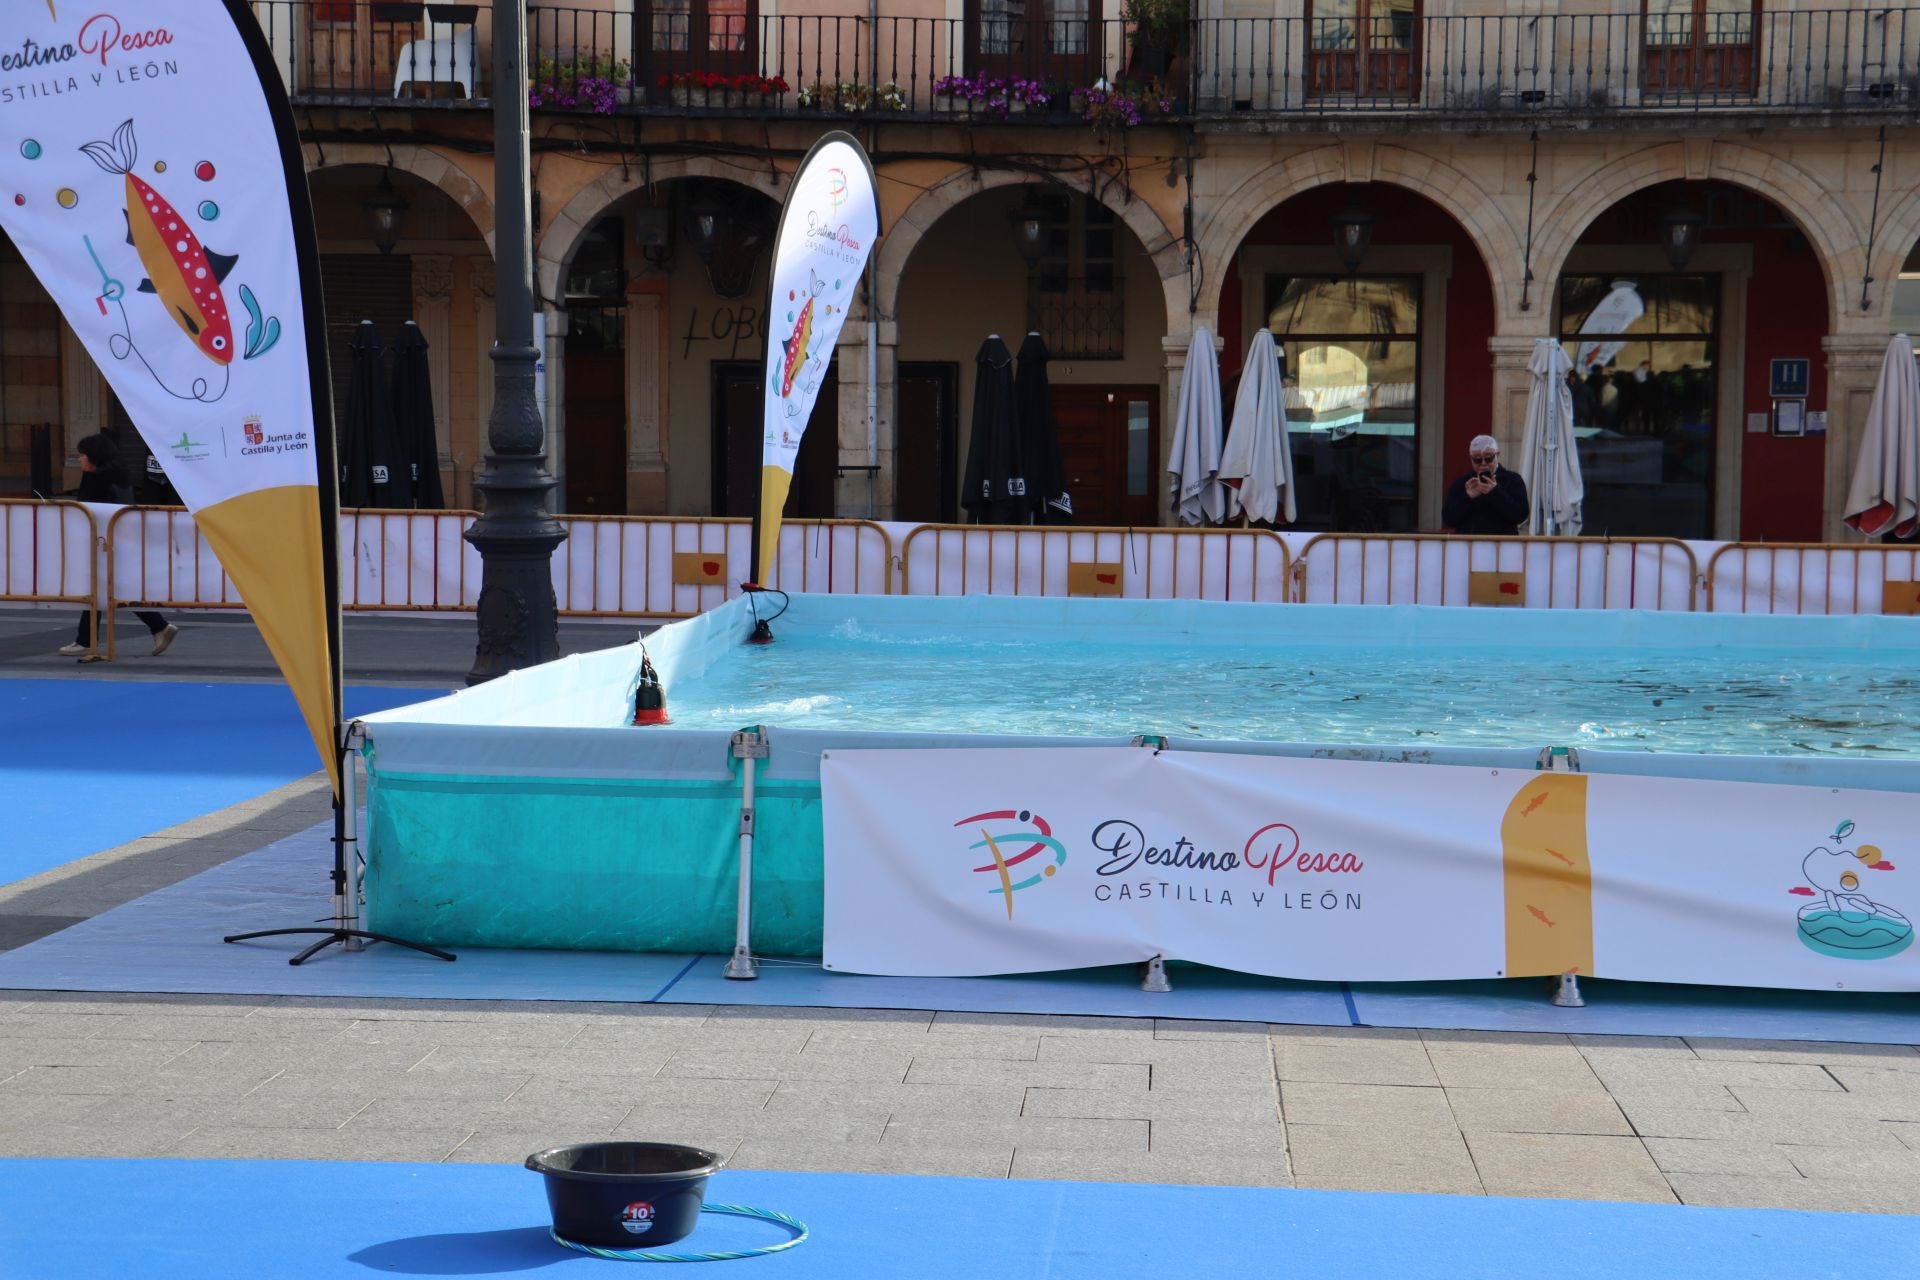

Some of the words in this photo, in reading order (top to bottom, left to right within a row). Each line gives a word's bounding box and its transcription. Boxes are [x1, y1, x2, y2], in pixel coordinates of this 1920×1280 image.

[1, 38, 77, 72] estino
[78, 13, 173, 66] Pesca
[1, 75, 78, 103] STILLA
[91, 73, 102, 87] Y
[117, 60, 178, 83] LEÓN
[837, 223, 860, 251] Pesca
[240, 445, 275, 456] Castilla
[276, 445, 282, 454] y
[284, 441, 308, 451] León
[266, 434, 293, 443] Junta
[295, 432, 307, 440] de
[1091, 819, 1241, 877] Destino
[1244, 823, 1364, 887] Pesca
[1094, 881, 1233, 906] CASTILLA
[1252, 892, 1265, 907] Y
[1284, 889, 1361, 910] LEÓN
[631, 1207, 648, 1219] 10
